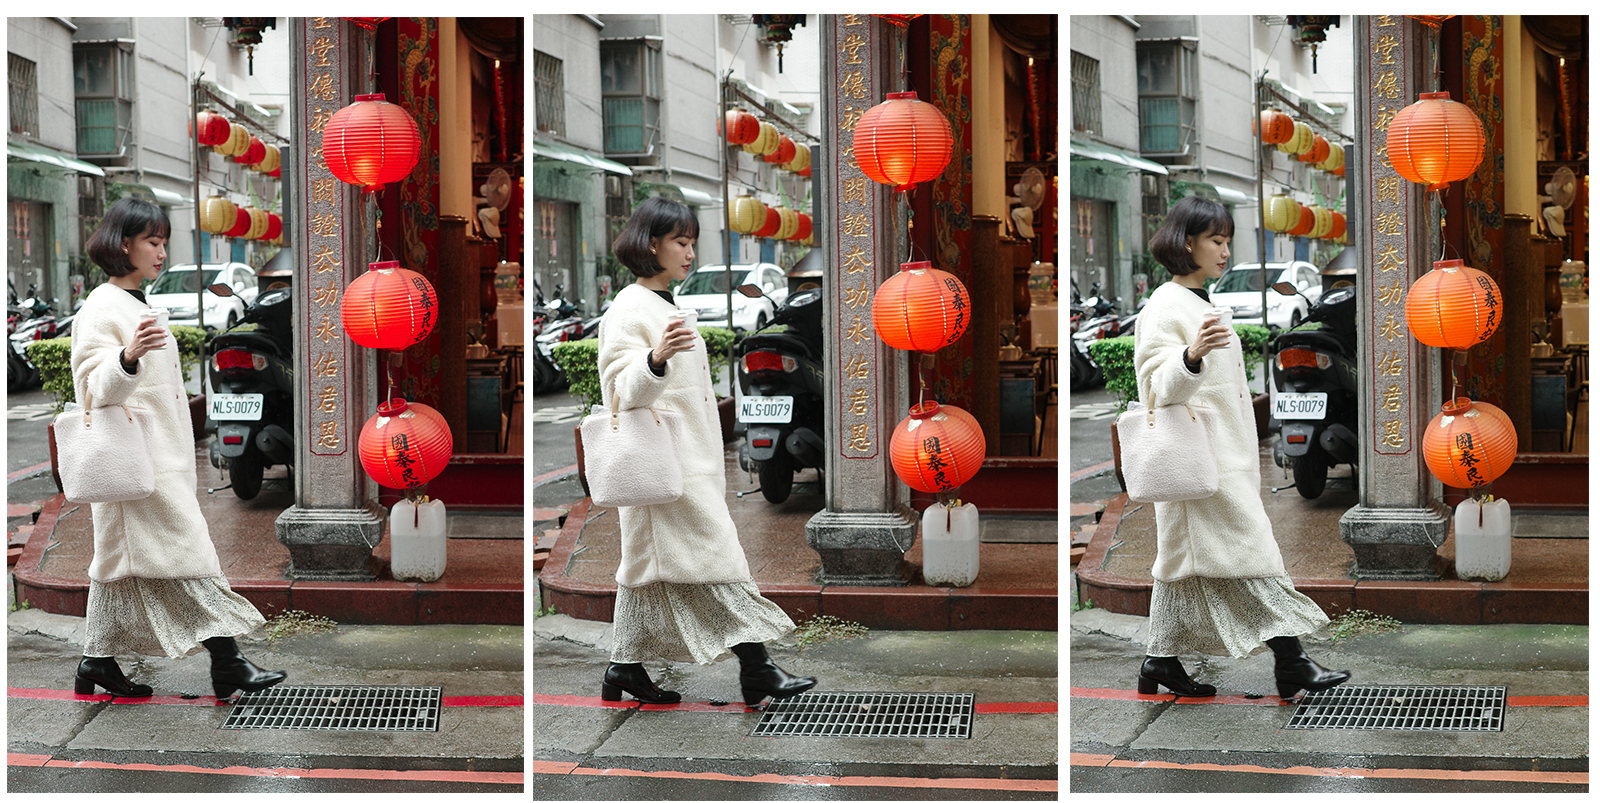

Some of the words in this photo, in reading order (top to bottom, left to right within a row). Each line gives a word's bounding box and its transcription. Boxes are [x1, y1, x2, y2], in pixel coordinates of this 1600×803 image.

[212, 401, 261, 414] NLS-0079
[741, 403, 791, 417] NLS-0079
[1276, 400, 1325, 413] NLS-0079
